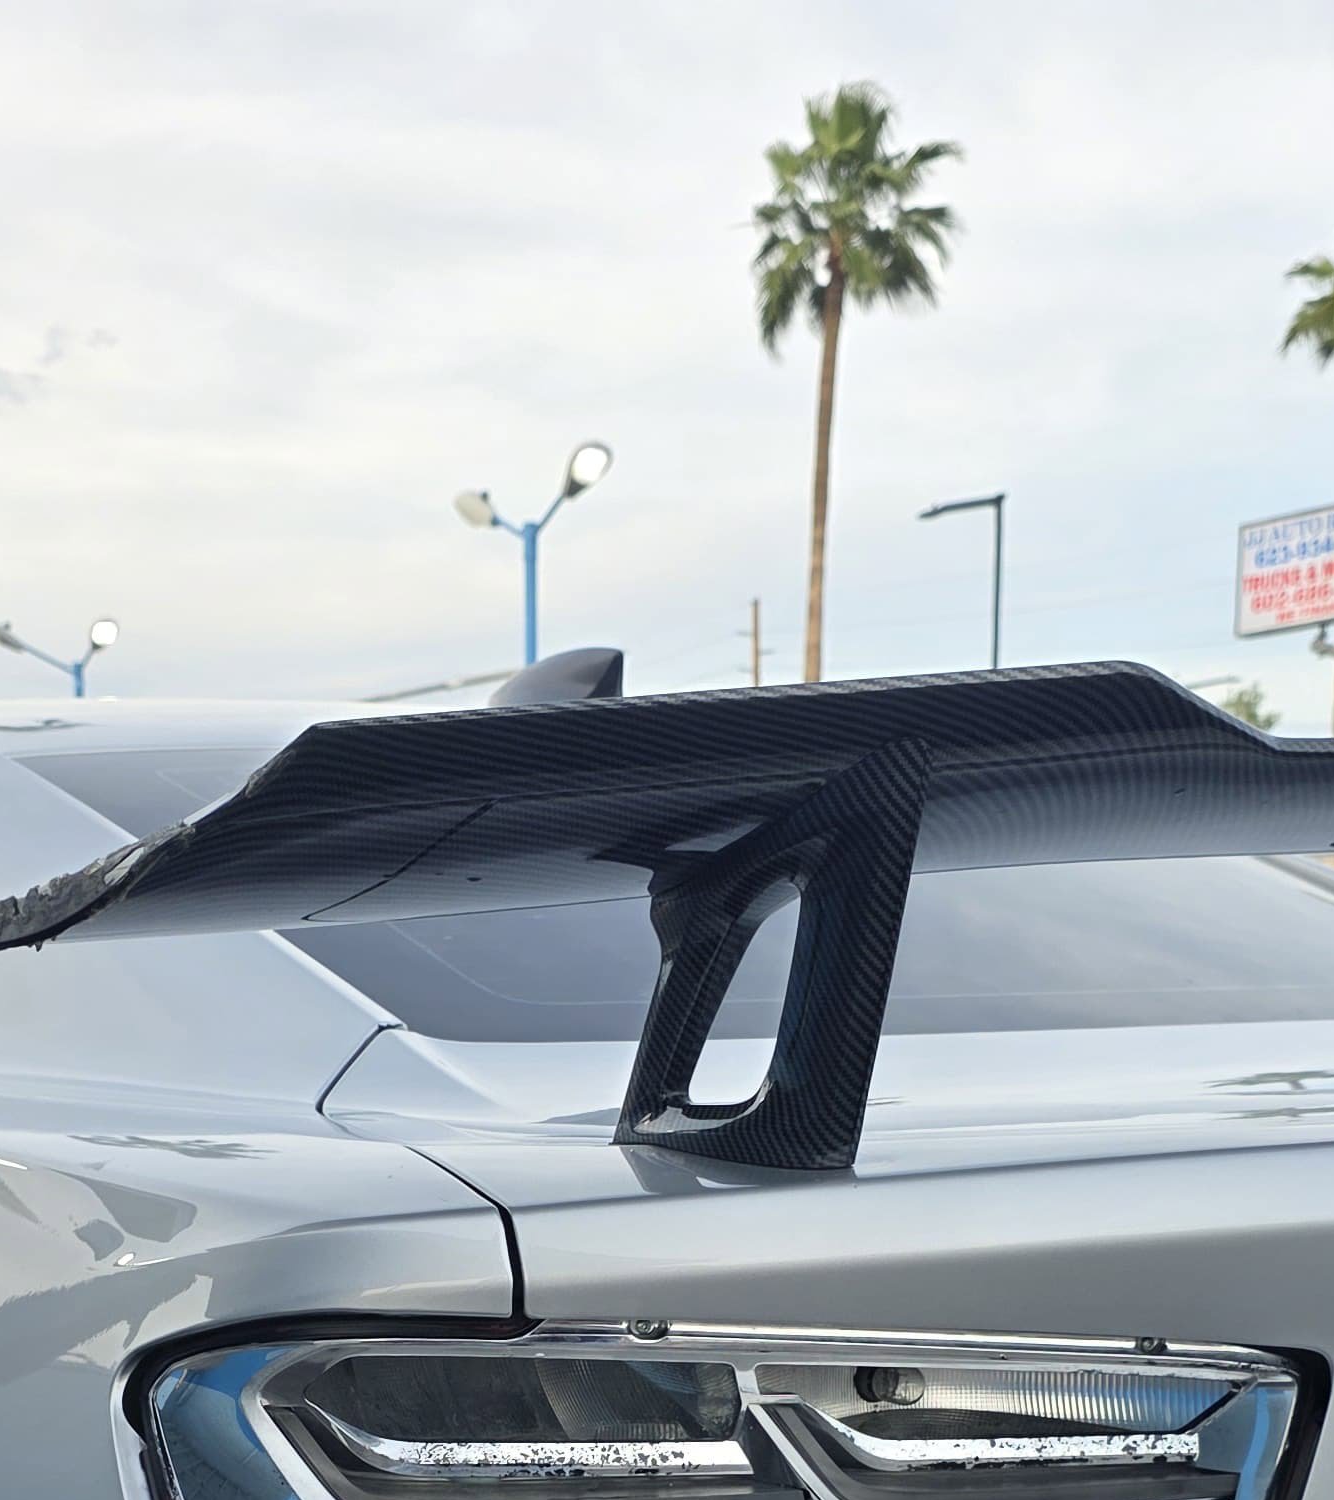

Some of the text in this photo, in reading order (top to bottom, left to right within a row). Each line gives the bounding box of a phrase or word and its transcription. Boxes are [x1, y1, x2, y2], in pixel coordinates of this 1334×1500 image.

[1269, 516, 1323, 541] AUTO
[1242, 567, 1301, 593] TRUCKS
[1306, 564, 1317, 583] &
